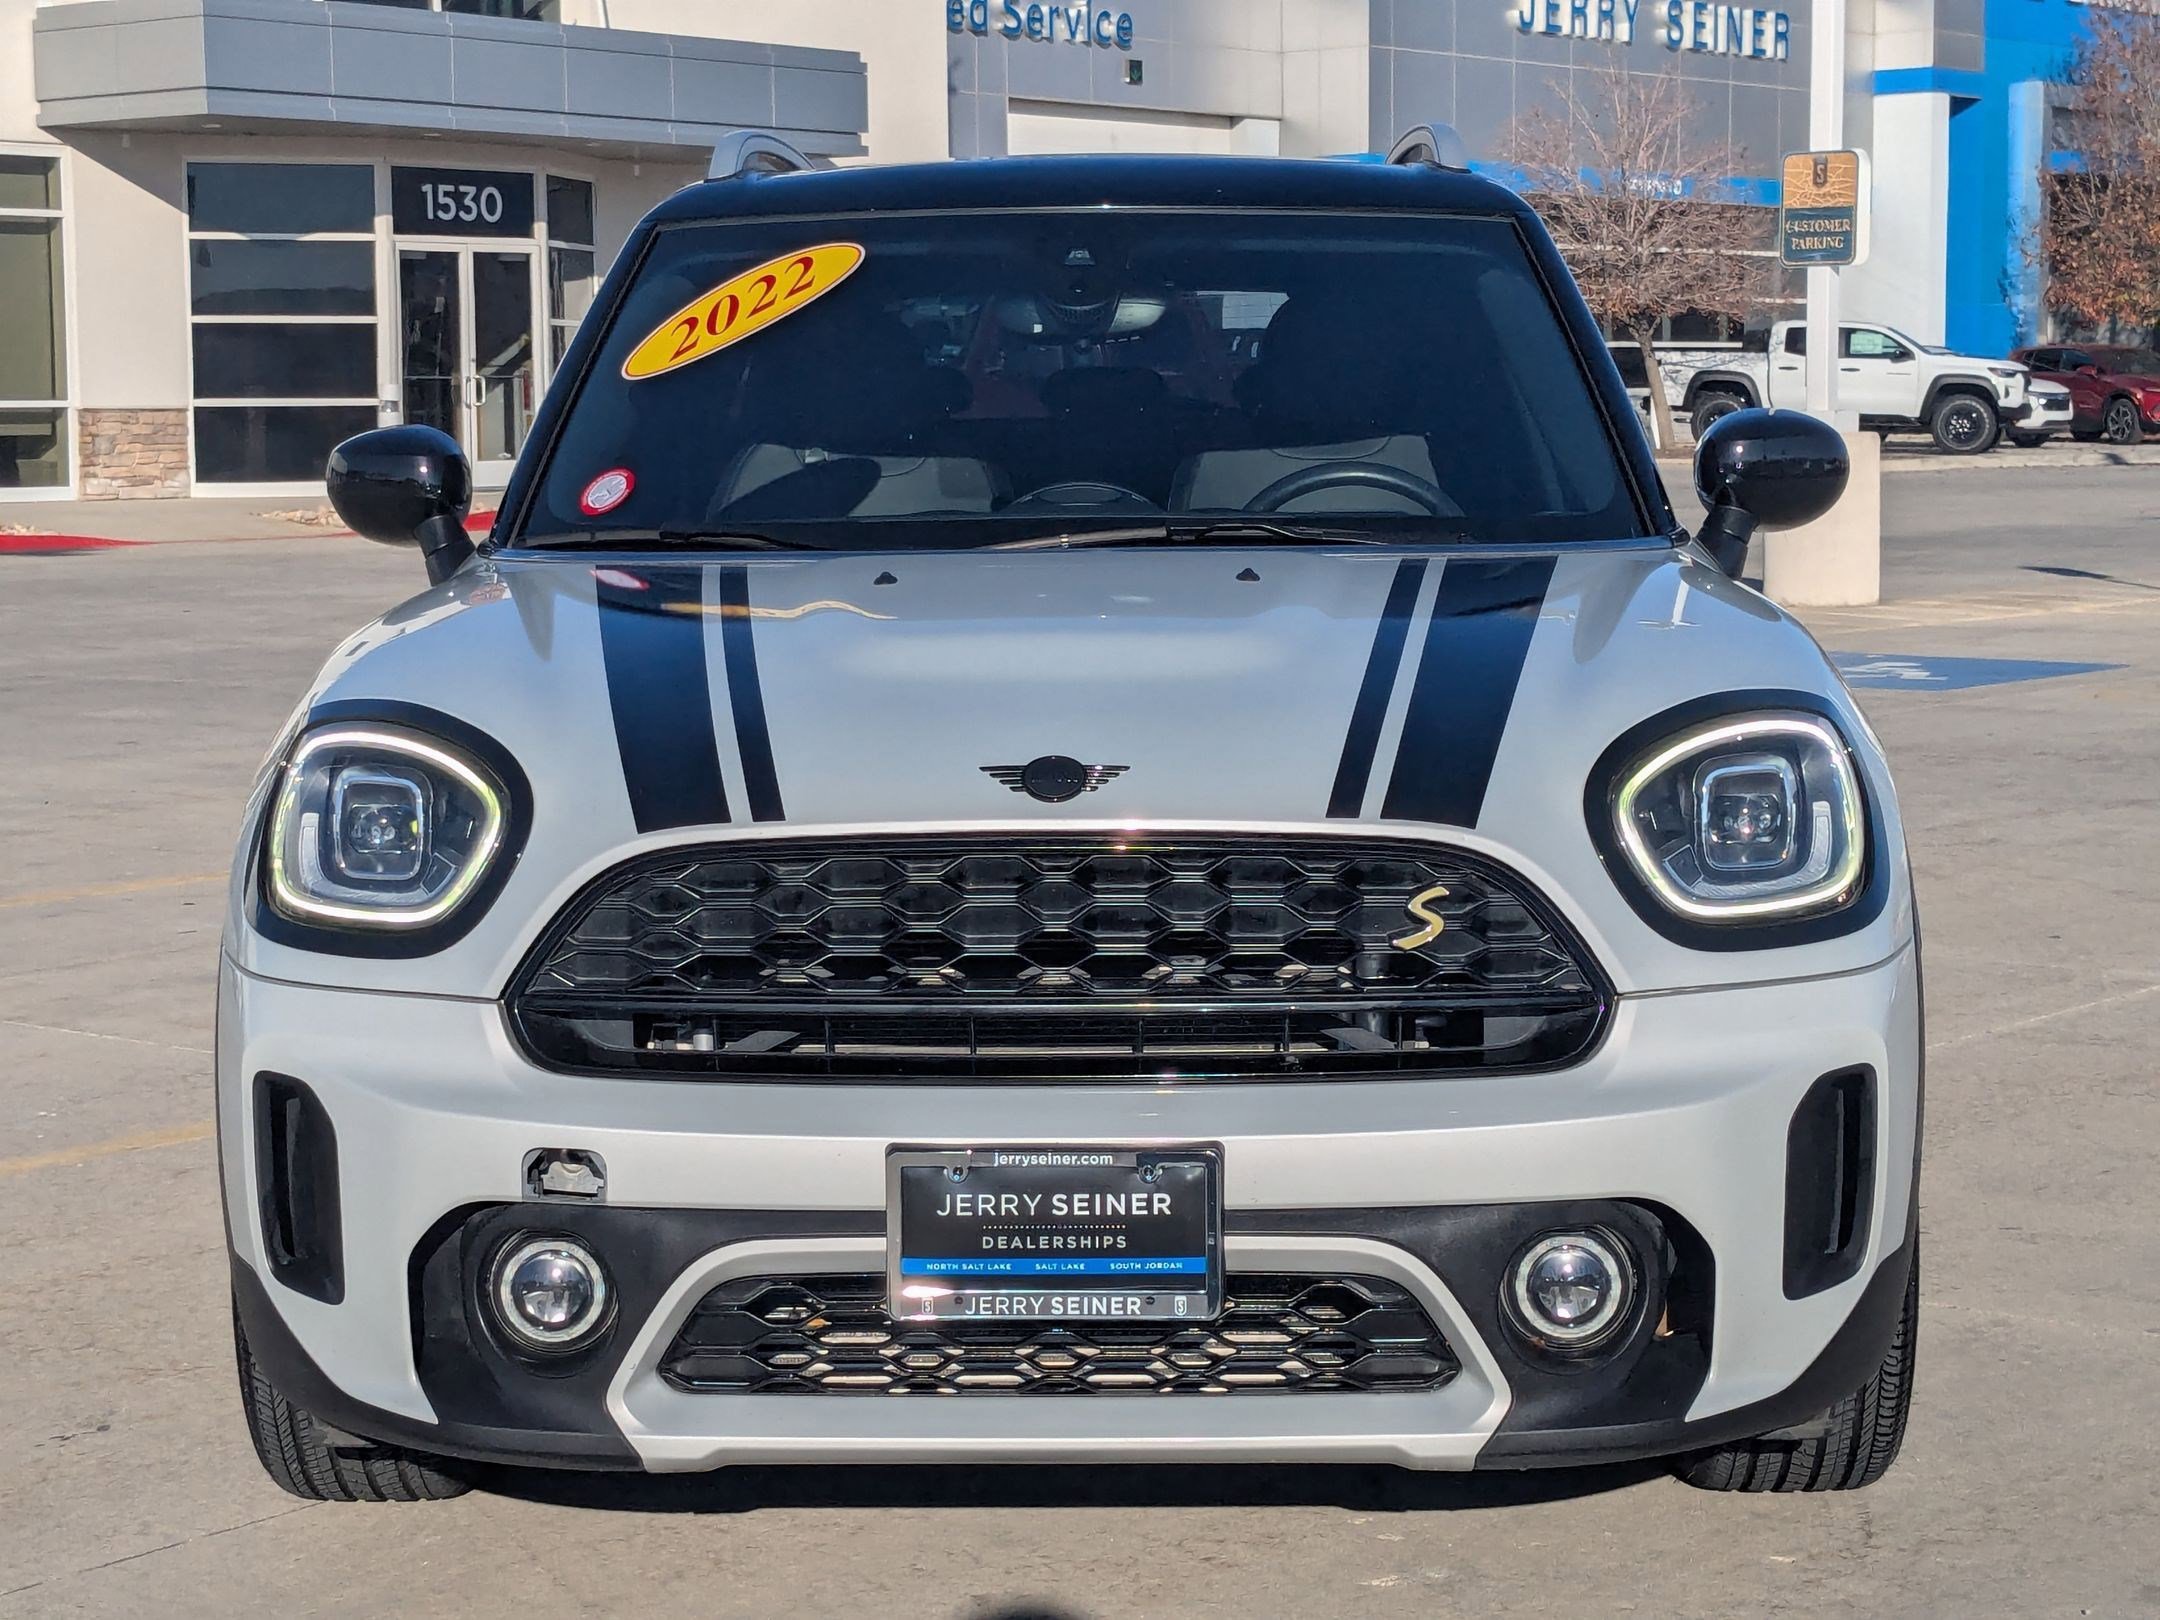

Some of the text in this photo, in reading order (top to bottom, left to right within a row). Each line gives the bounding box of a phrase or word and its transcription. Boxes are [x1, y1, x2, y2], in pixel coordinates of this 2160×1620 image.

[1000, 0, 1132, 47] Service
[1518, 0, 1790, 60] JERRY SEINER
[421, 184, 503, 223] 1530
[1786, 218, 1851, 233] CUSTOMER
[1791, 236, 1844, 250] PARKING
[669, 256, 816, 363] 2022
[1391, 885, 1450, 951] S
[993, 1152, 1113, 1167] jerryseiner.com
[936, 1193, 1172, 1217] JERRY SEINER
[982, 1235, 1127, 1249] DEALERSHIPS
[926, 1263, 1012, 1271] NORTH SALT LAKE
[1035, 1263, 1058, 1271] SALT
[1144, 1262, 1183, 1270] JORDAN
[965, 1296, 1141, 1315] JERRY SEINER
